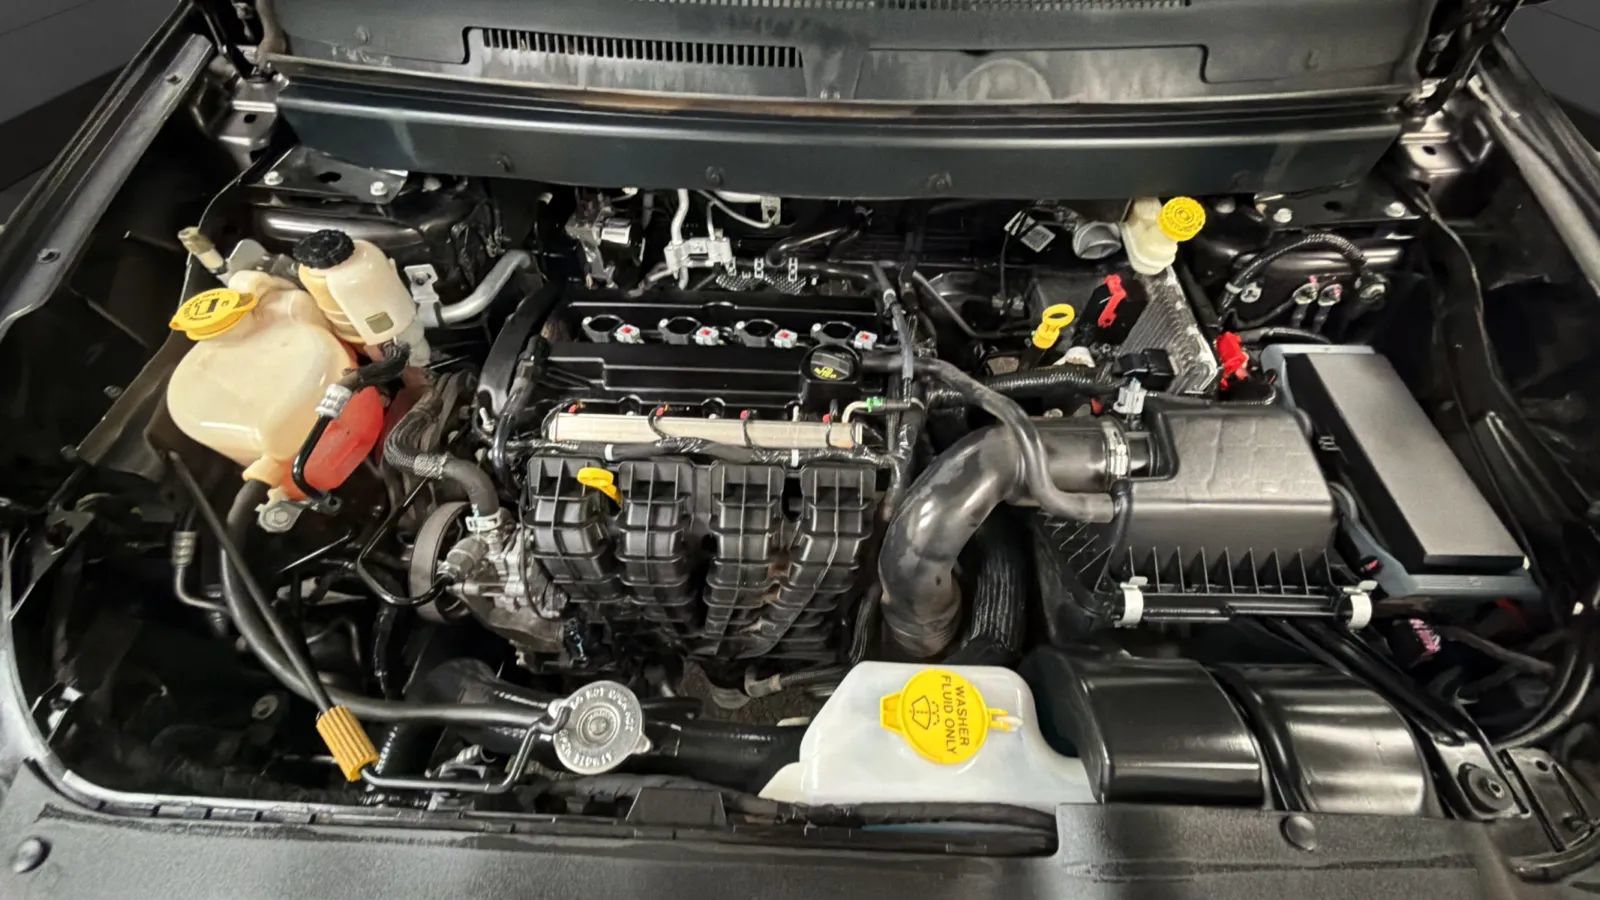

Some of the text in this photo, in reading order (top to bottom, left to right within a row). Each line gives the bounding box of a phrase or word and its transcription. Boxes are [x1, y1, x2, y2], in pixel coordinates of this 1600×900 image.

[941, 675, 957, 754] FLUID ONLY
[955, 686, 970, 746] WASHER
